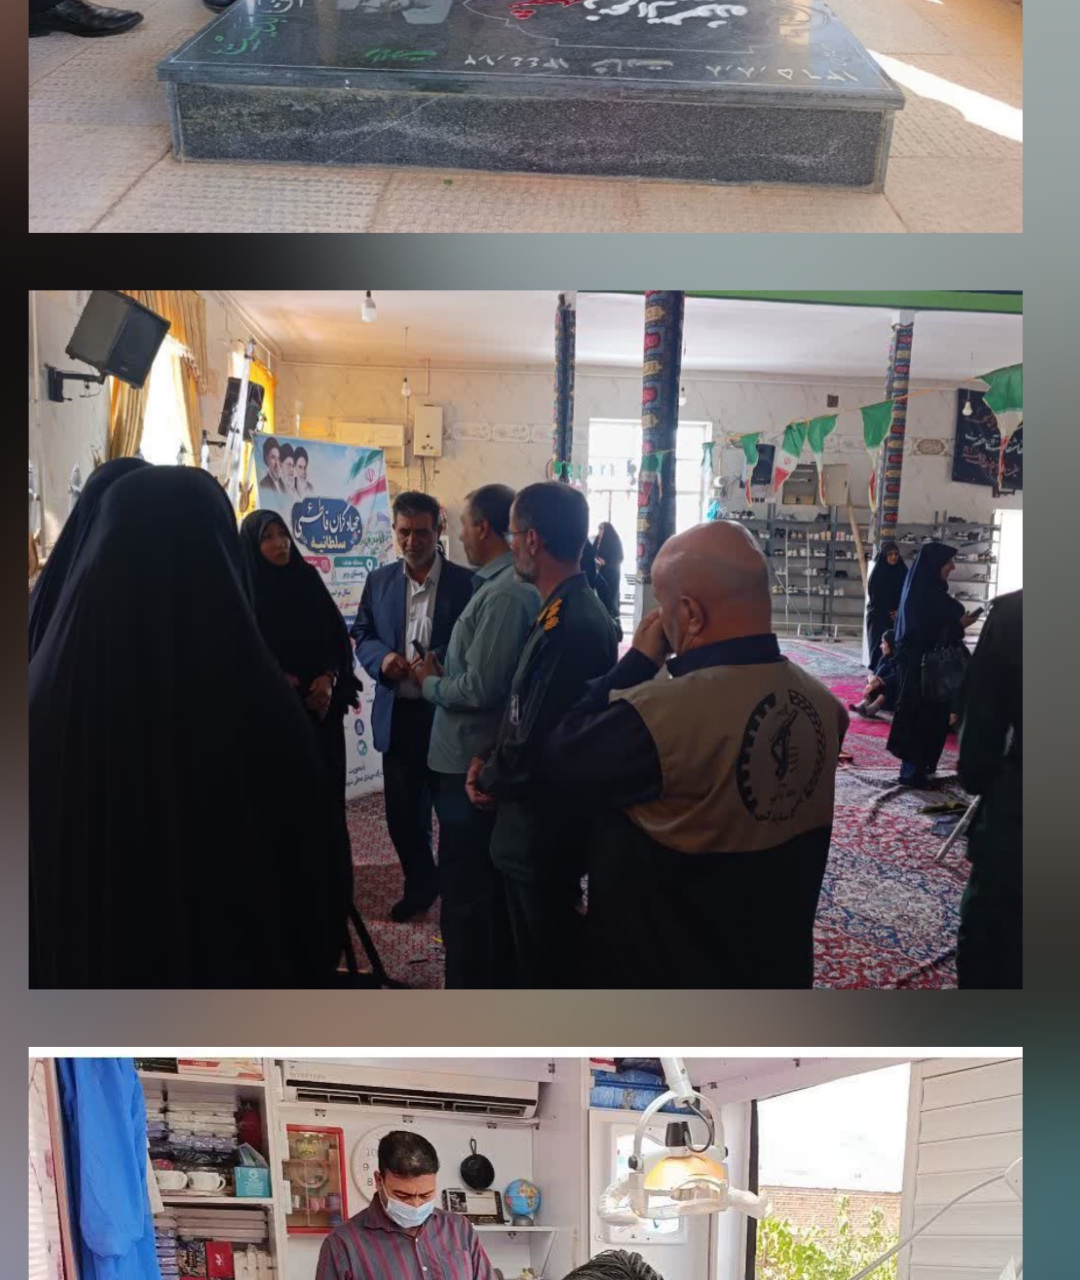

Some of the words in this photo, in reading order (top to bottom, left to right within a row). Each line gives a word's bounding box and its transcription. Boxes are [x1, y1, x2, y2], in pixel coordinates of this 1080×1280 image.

[311, 535, 346, 553] سلطانیه
[363, 1162, 369, 1172] 9
[367, 1177, 374, 1187] 8
